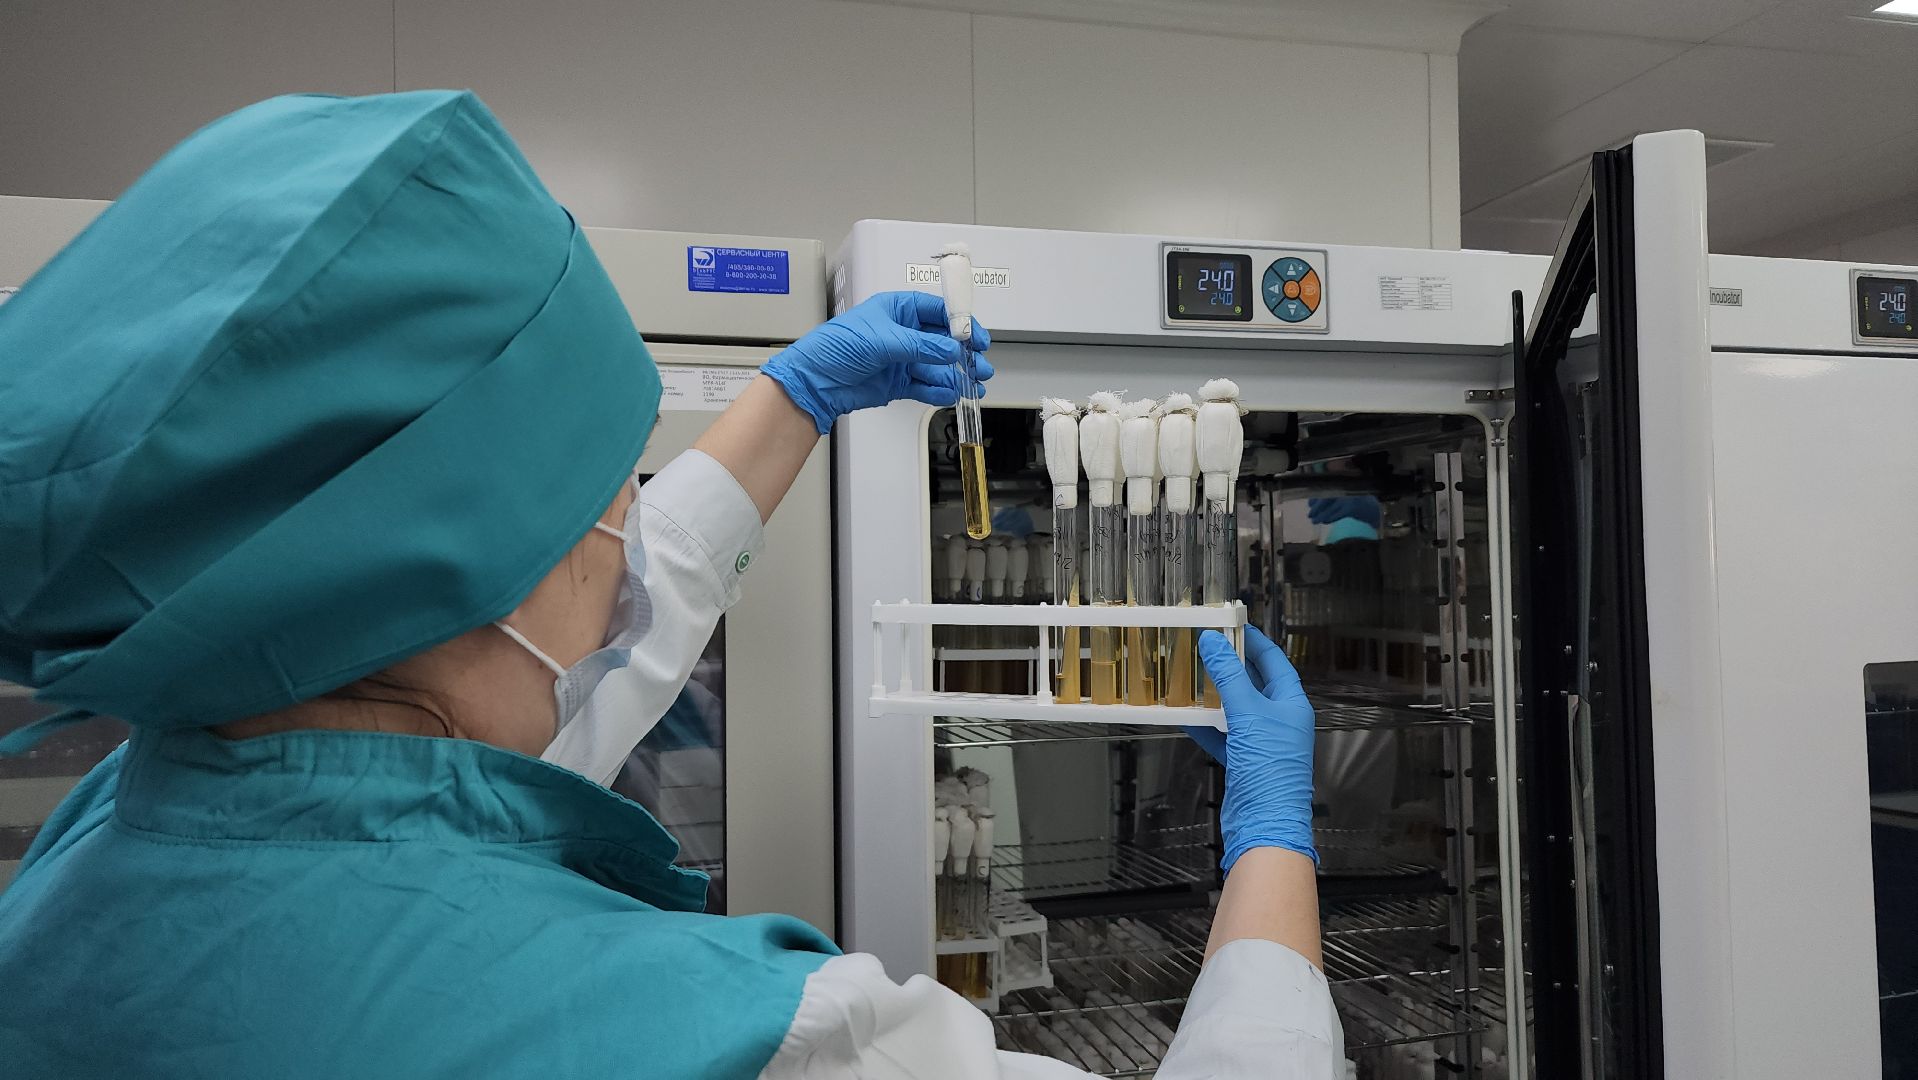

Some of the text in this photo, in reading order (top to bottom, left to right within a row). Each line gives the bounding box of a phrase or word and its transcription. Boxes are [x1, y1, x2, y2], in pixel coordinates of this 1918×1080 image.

[716, 248, 785, 259] СЕРВИСНЫЙ ЦЕНТР
[973, 269, 1006, 285] cubator
[1198, 269, 1234, 292] 24.0
